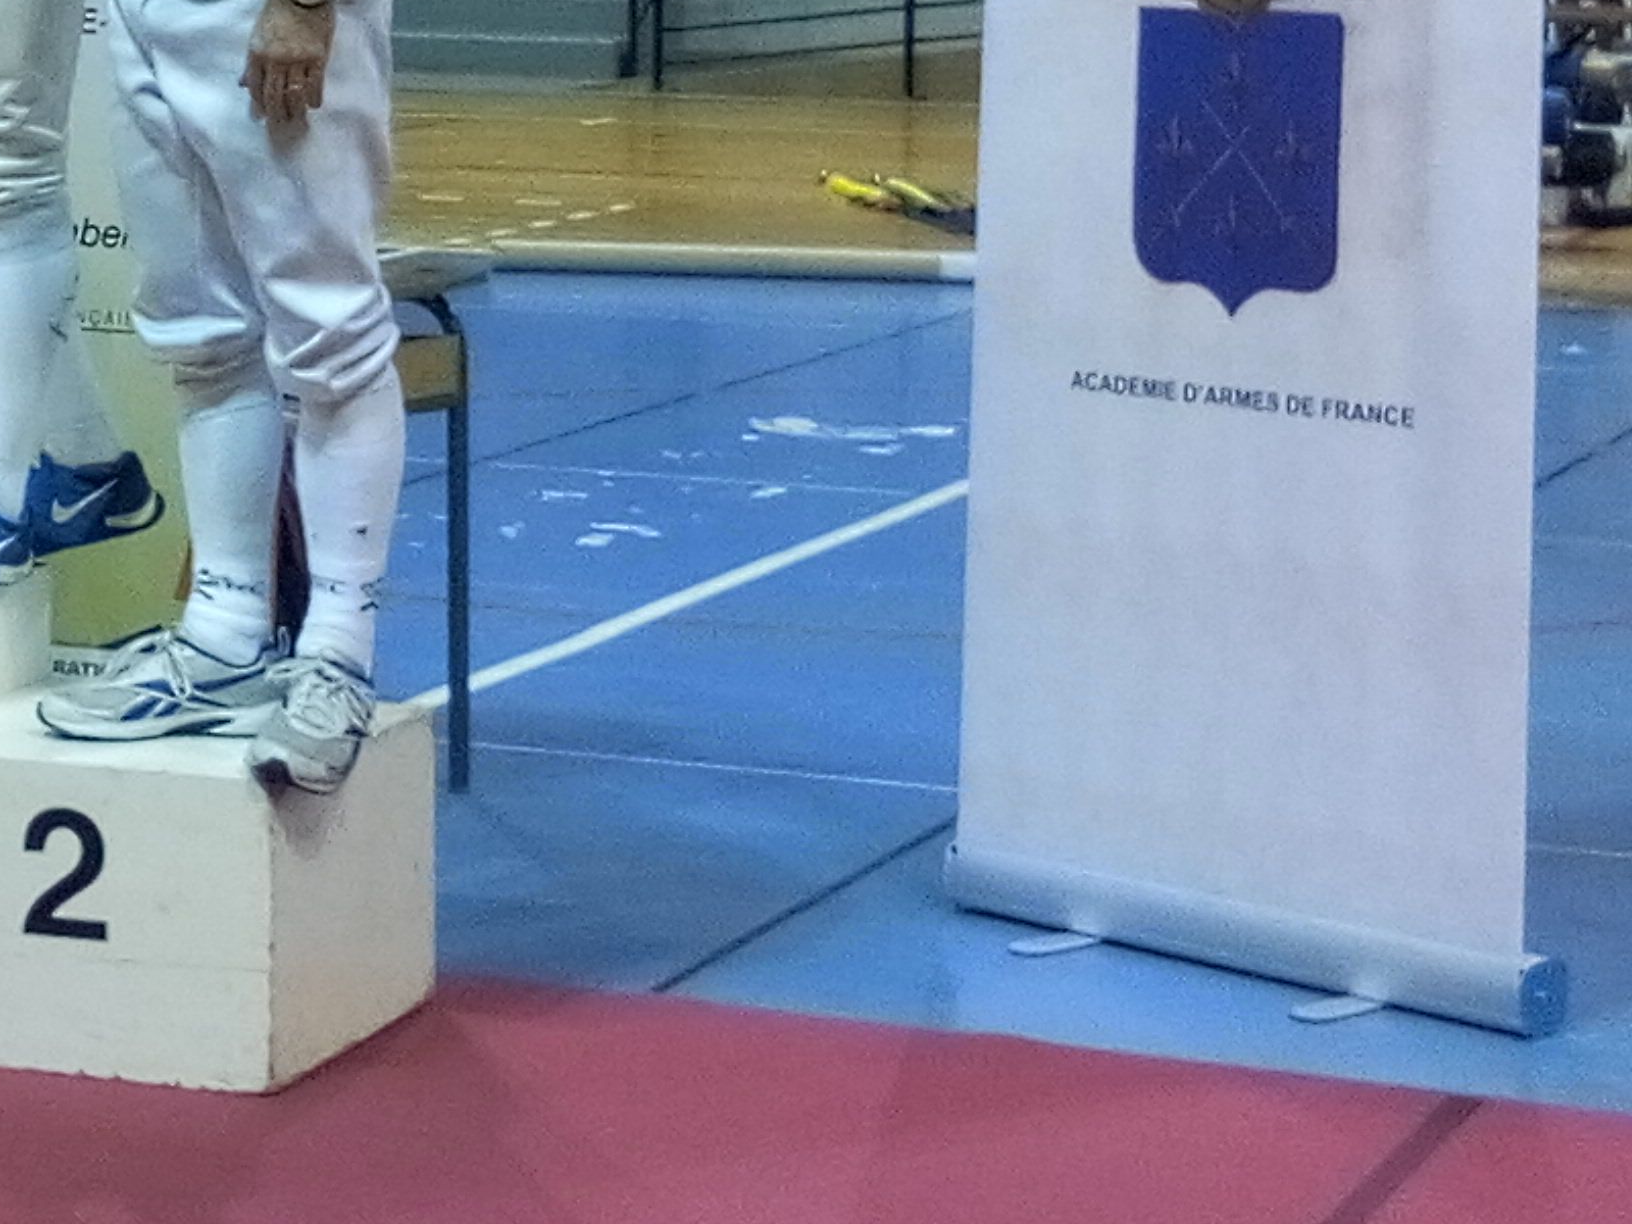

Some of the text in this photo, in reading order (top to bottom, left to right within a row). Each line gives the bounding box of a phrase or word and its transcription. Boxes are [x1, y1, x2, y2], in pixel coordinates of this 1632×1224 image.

[1070, 370, 1415, 428] ACADEMIE D'ARMES DE FRANCE
[22, 807, 108, 942] 2
